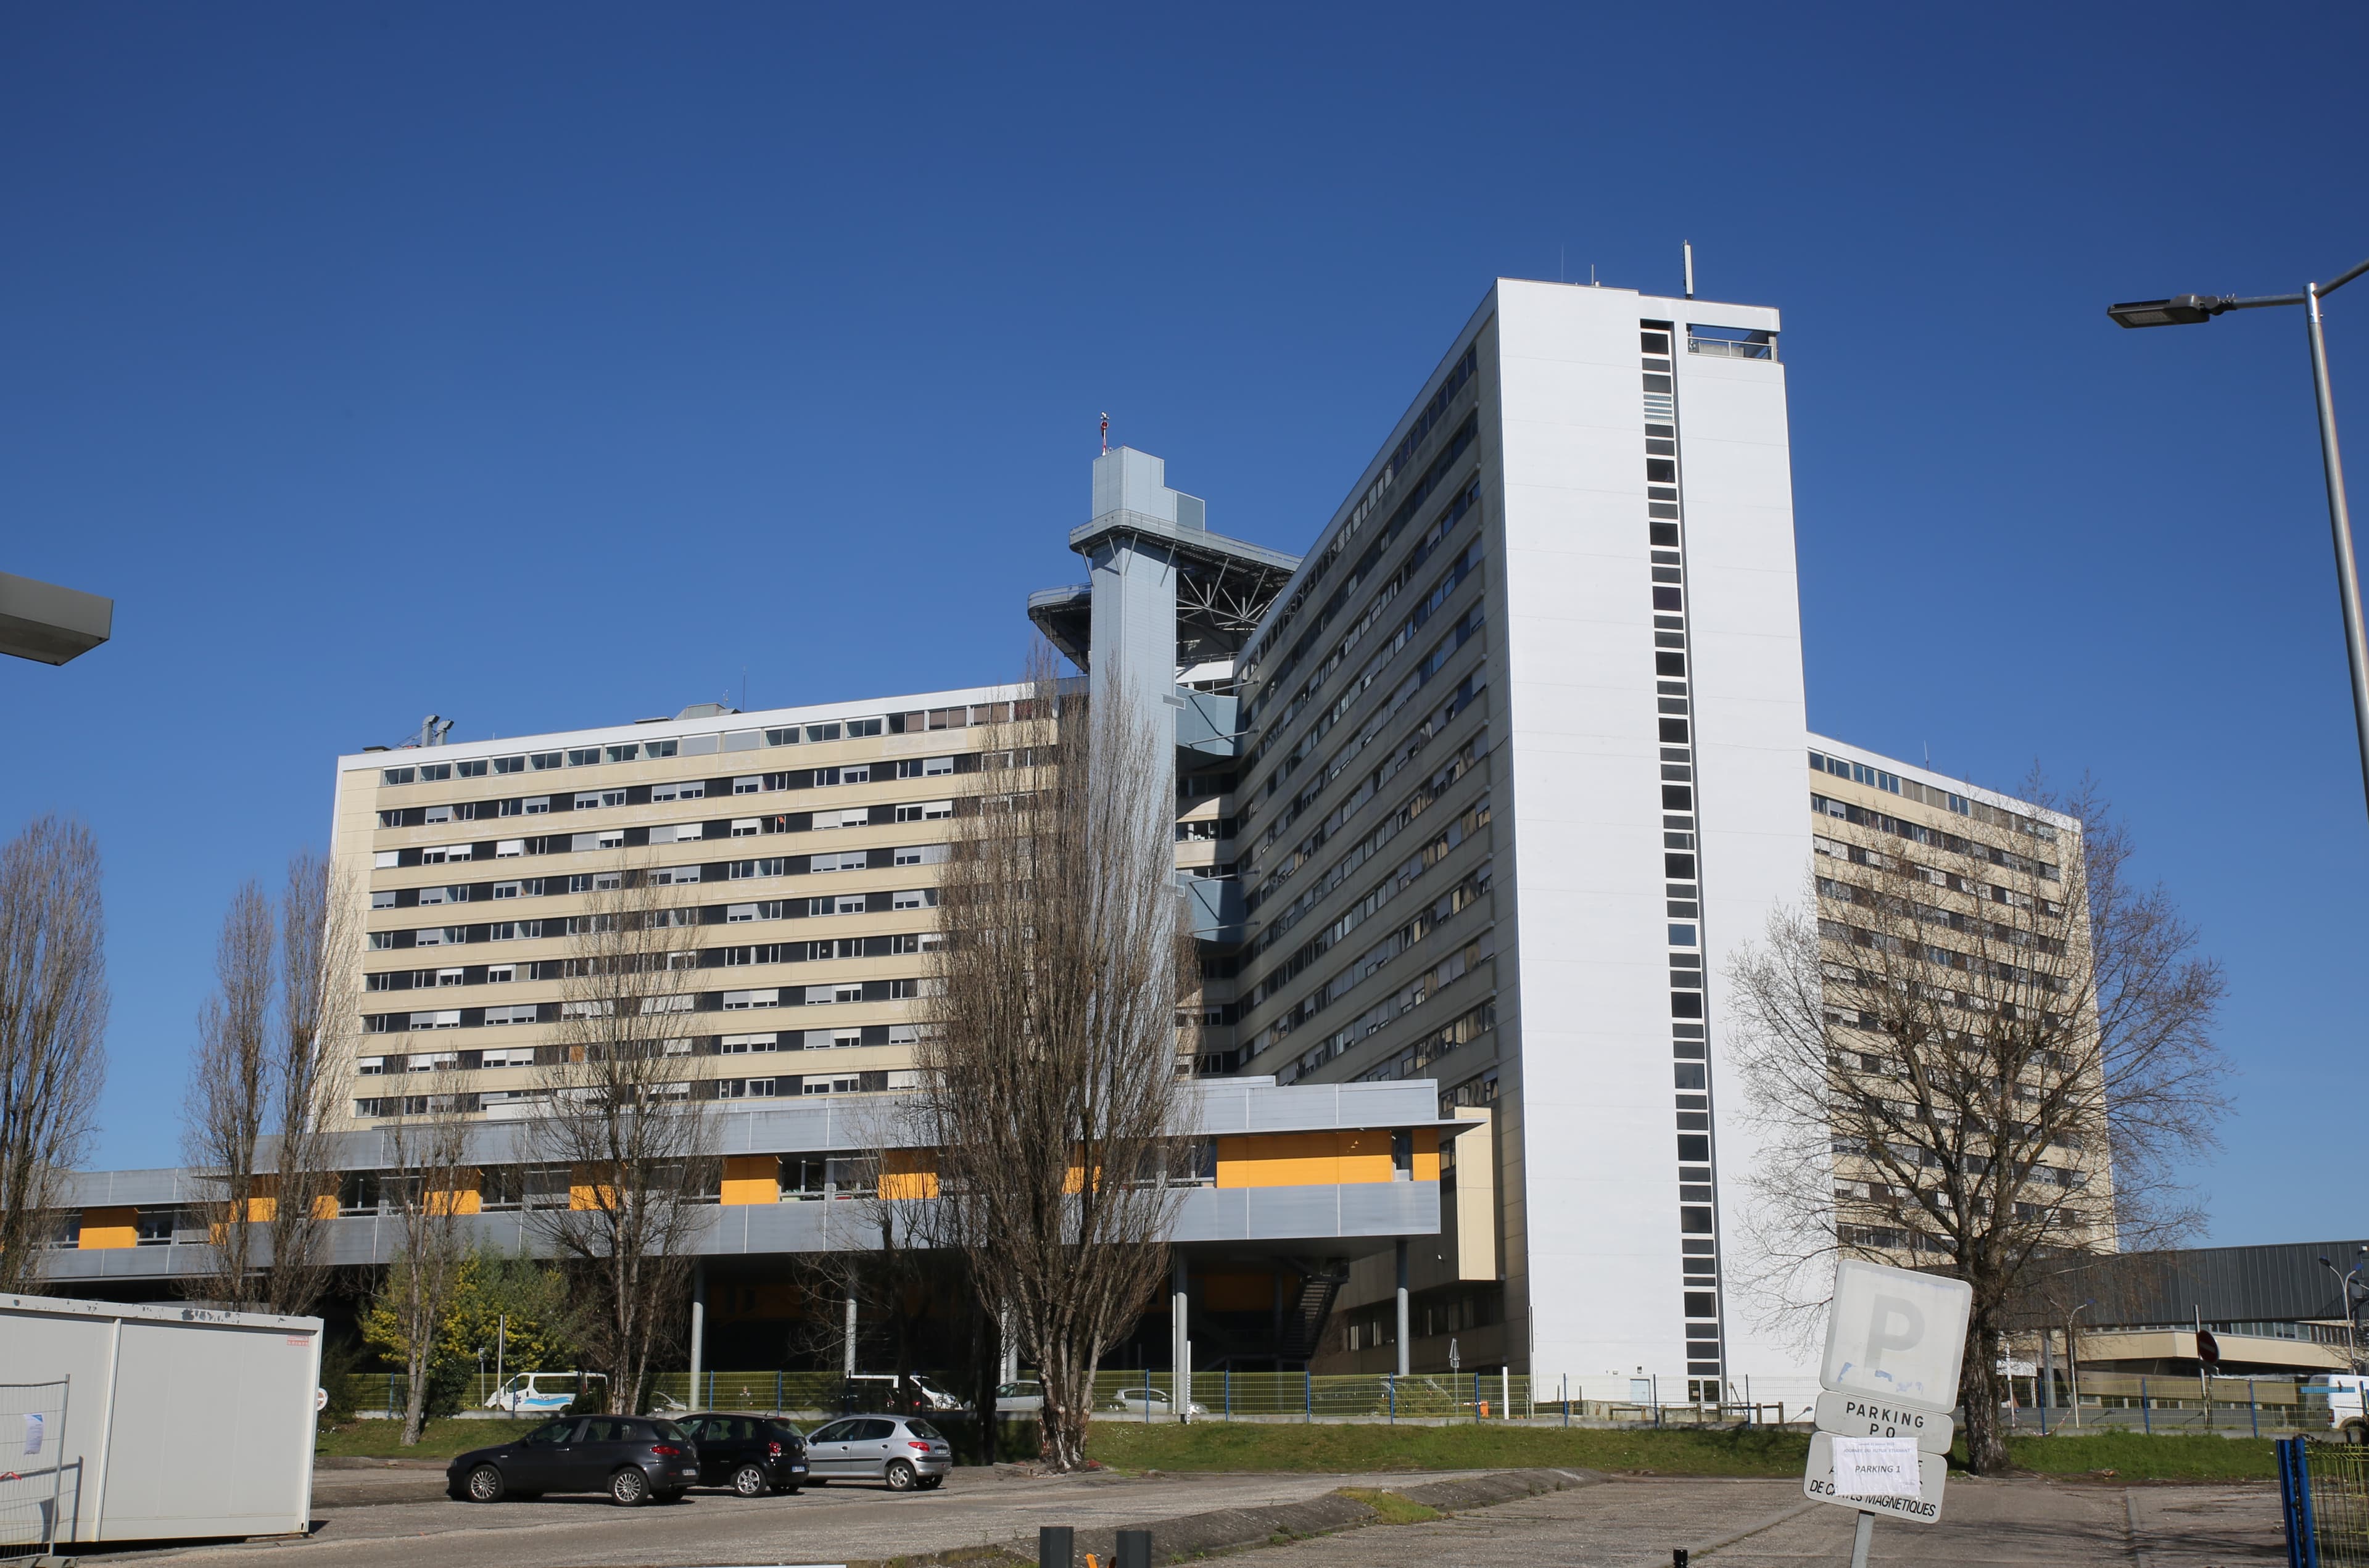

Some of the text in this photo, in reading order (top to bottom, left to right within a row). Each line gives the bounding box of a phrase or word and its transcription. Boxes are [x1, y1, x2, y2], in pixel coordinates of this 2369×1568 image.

[1864, 1293, 1925, 1370] P
[1846, 1401, 1924, 1428] PARKING
[1854, 1465, 1901, 1473] PARKING 1
[1809, 1479, 1824, 1493] DE
[1865, 1495, 1936, 1517] MAGNETIQUES
